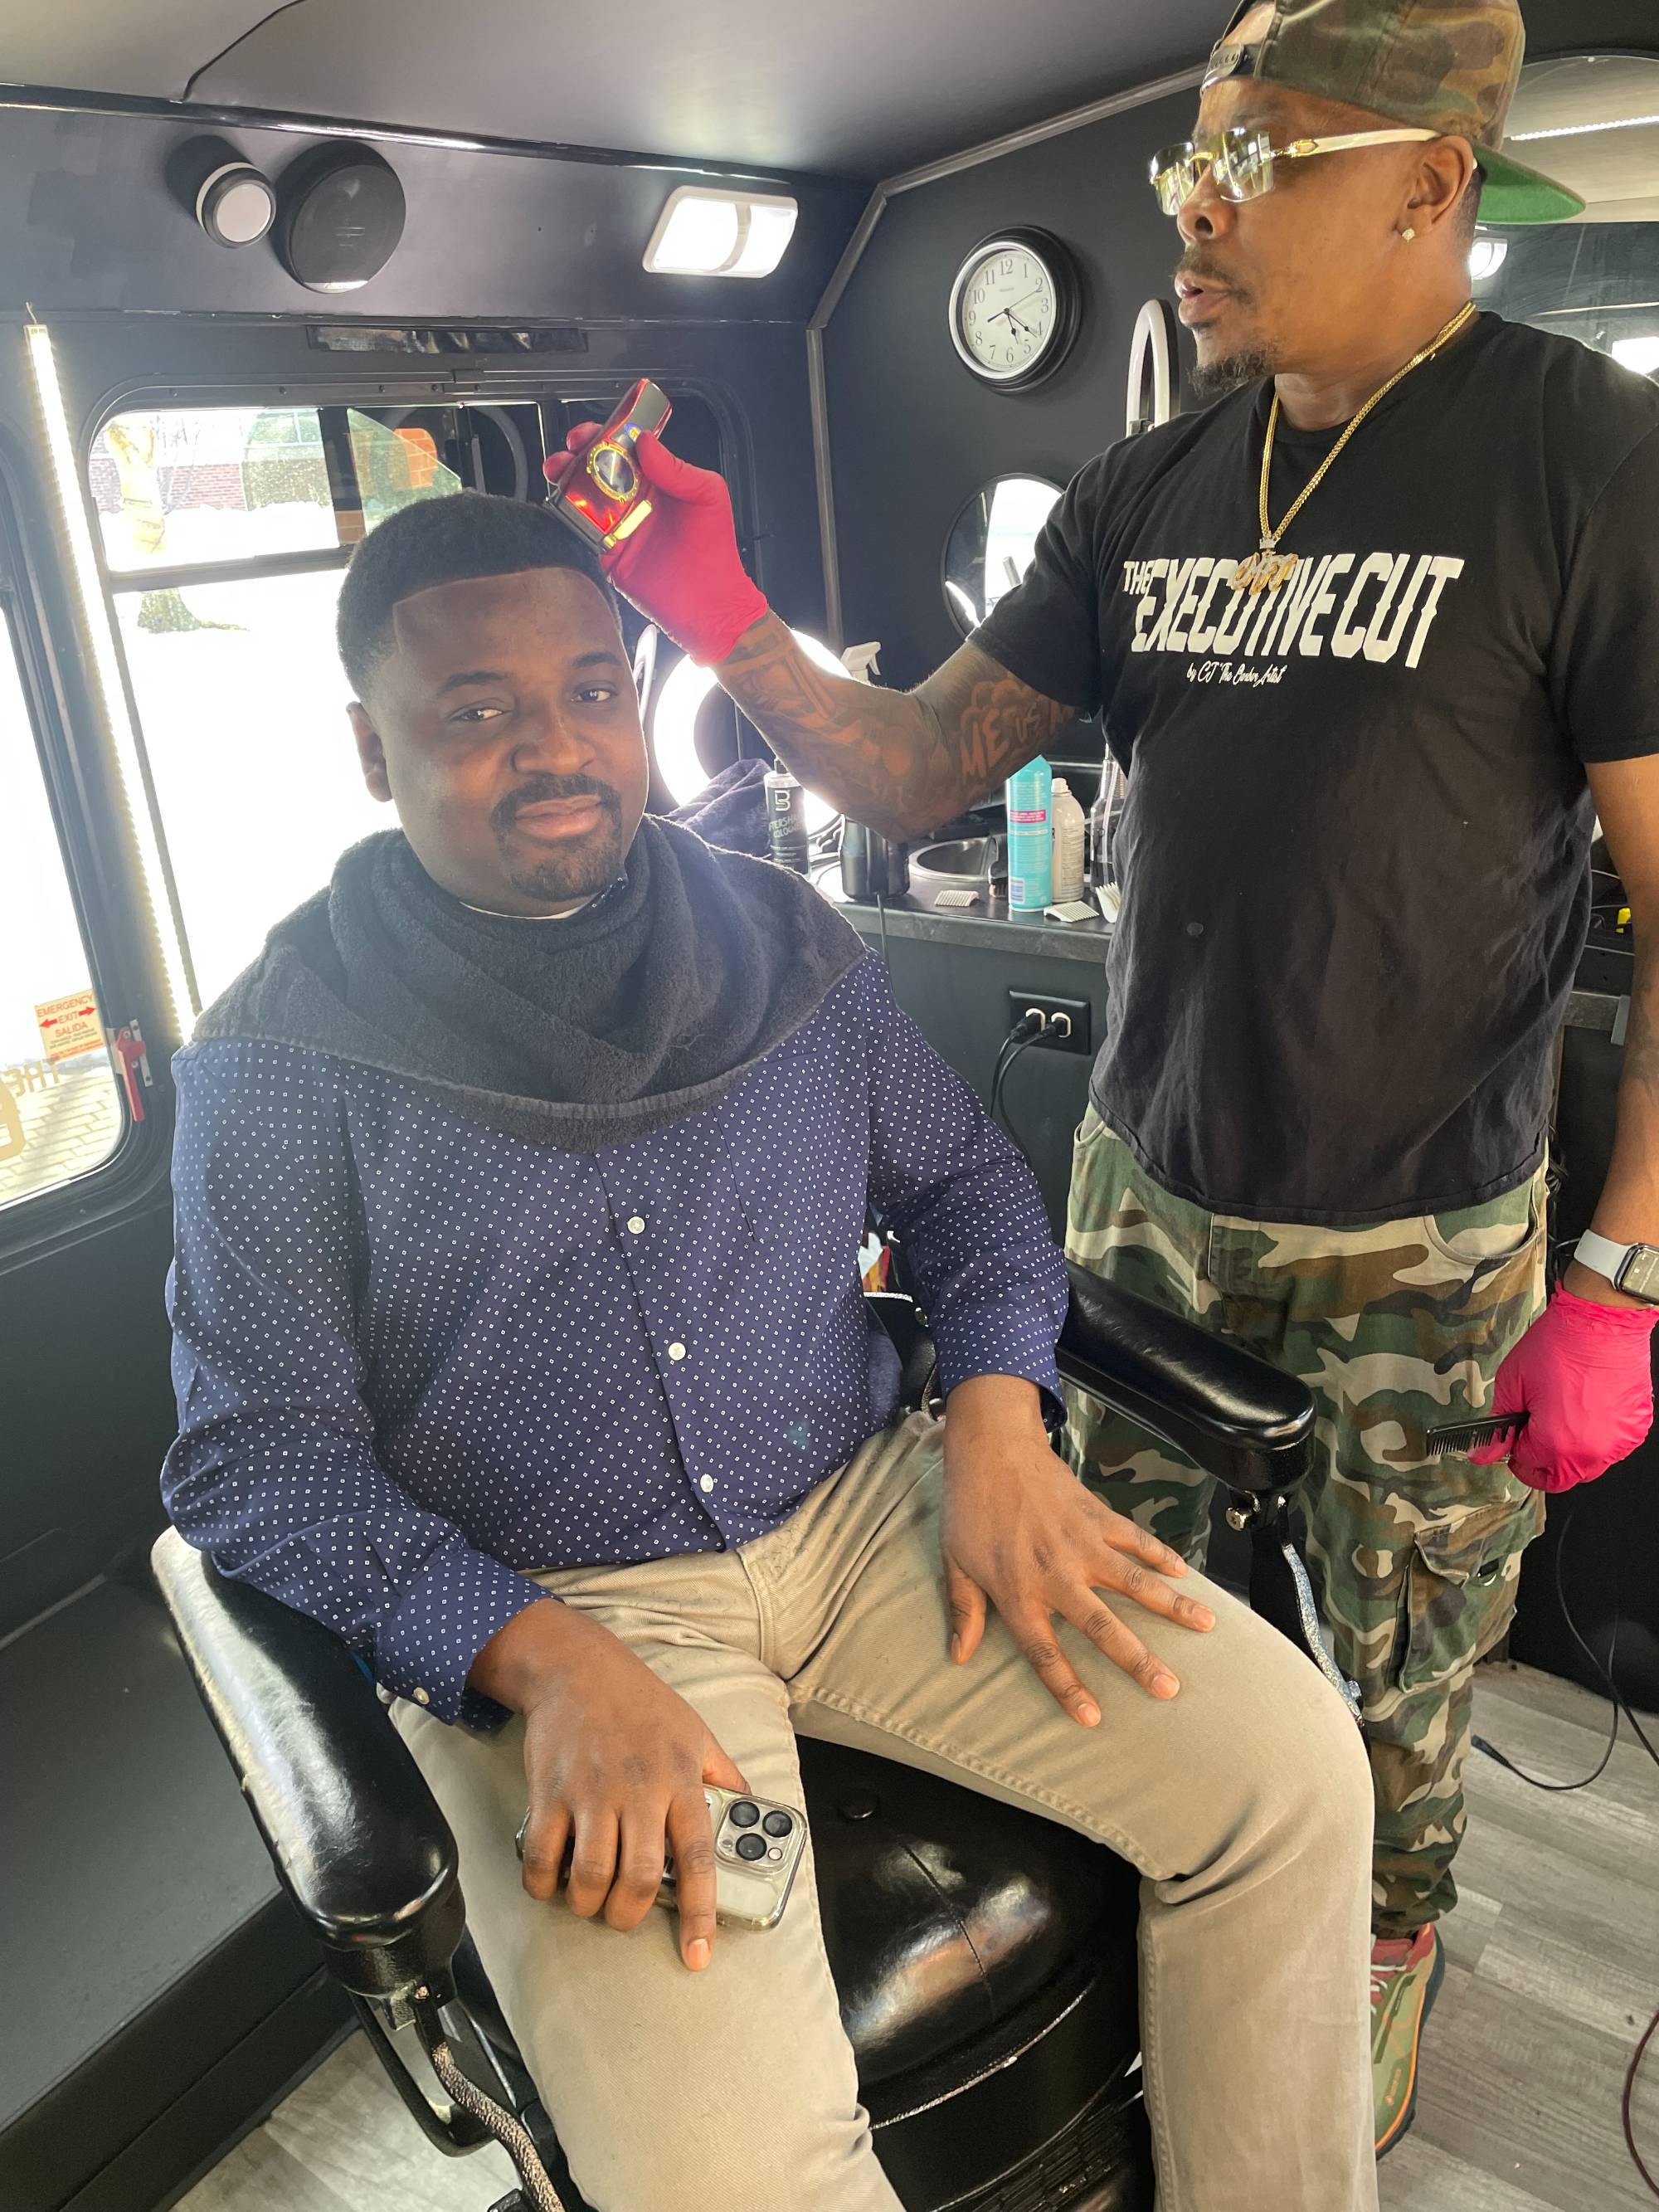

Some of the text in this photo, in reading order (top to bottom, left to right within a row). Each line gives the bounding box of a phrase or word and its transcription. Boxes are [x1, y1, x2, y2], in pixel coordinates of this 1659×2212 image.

[1000, 258, 1013, 275] 12
[1024, 263, 1029, 279] 1
[985, 269, 995, 285] 11
[1034, 277, 1044, 293] 2
[973, 288, 985, 305] 10
[1040, 298, 1049, 314] 3
[968, 310, 976, 326] 9
[1030, 320, 1043, 336] 4
[975, 330, 983, 346] 8
[988, 344, 996, 360] 7
[1024, 339, 1031, 354] 5
[1005, 347, 1014, 363] 6
[1123, 561, 1155, 594] THE
[1331, 552, 1465, 668] CUT
[1186, 663, 1197, 682] by
[36, 994, 94, 1017] EMERGENCY
[58, 1011, 79, 1024] EXIT
[55, 1021, 88, 1037] SALIDA
